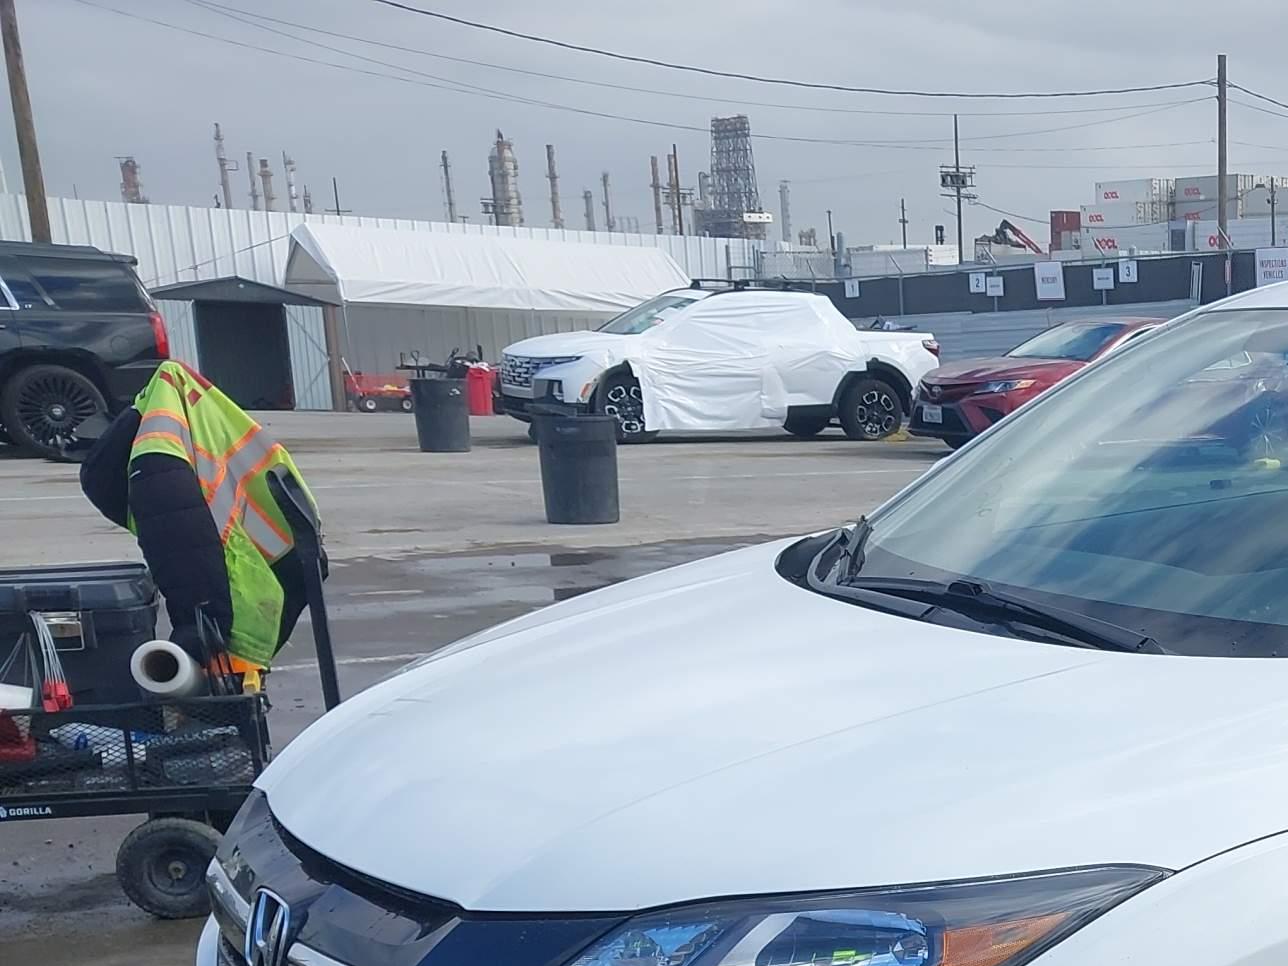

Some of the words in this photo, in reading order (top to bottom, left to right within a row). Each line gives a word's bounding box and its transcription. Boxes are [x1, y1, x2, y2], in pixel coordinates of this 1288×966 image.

[1125, 266, 1131, 277] 3
[975, 278, 981, 289] 2
[8, 806, 52, 817] GORILLA
